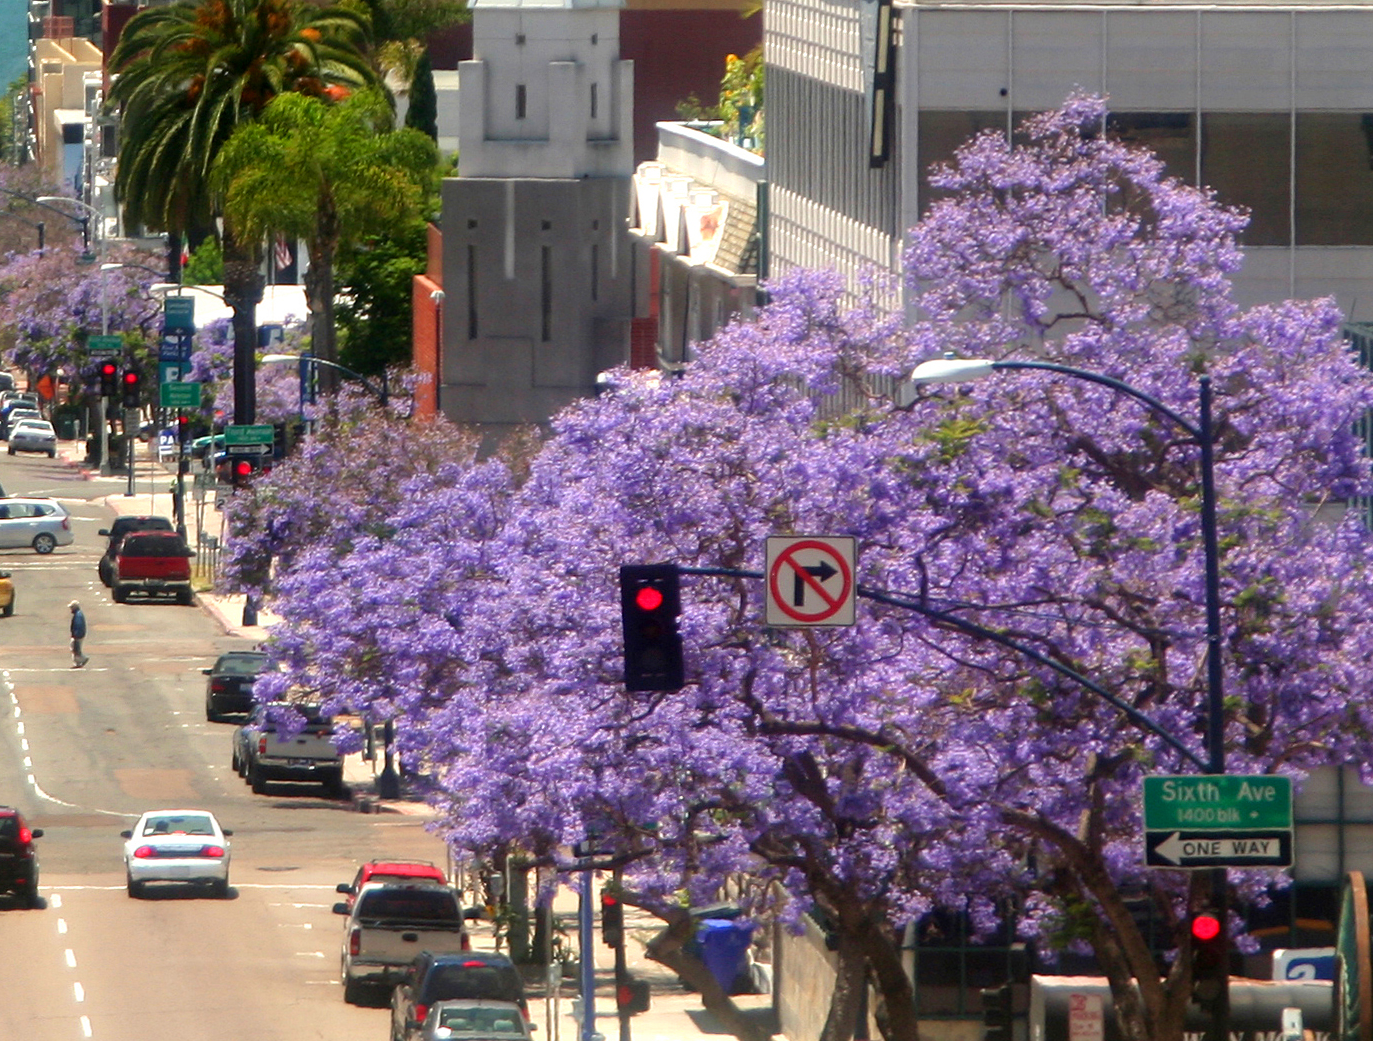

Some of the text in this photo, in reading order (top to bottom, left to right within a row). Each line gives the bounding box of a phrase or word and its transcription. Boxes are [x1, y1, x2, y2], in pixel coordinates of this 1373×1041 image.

[1161, 780, 1277, 802] Sixth Ave
[1177, 807, 1241, 822] 1400 blk
[1182, 841, 1270, 856] ONE WAY
